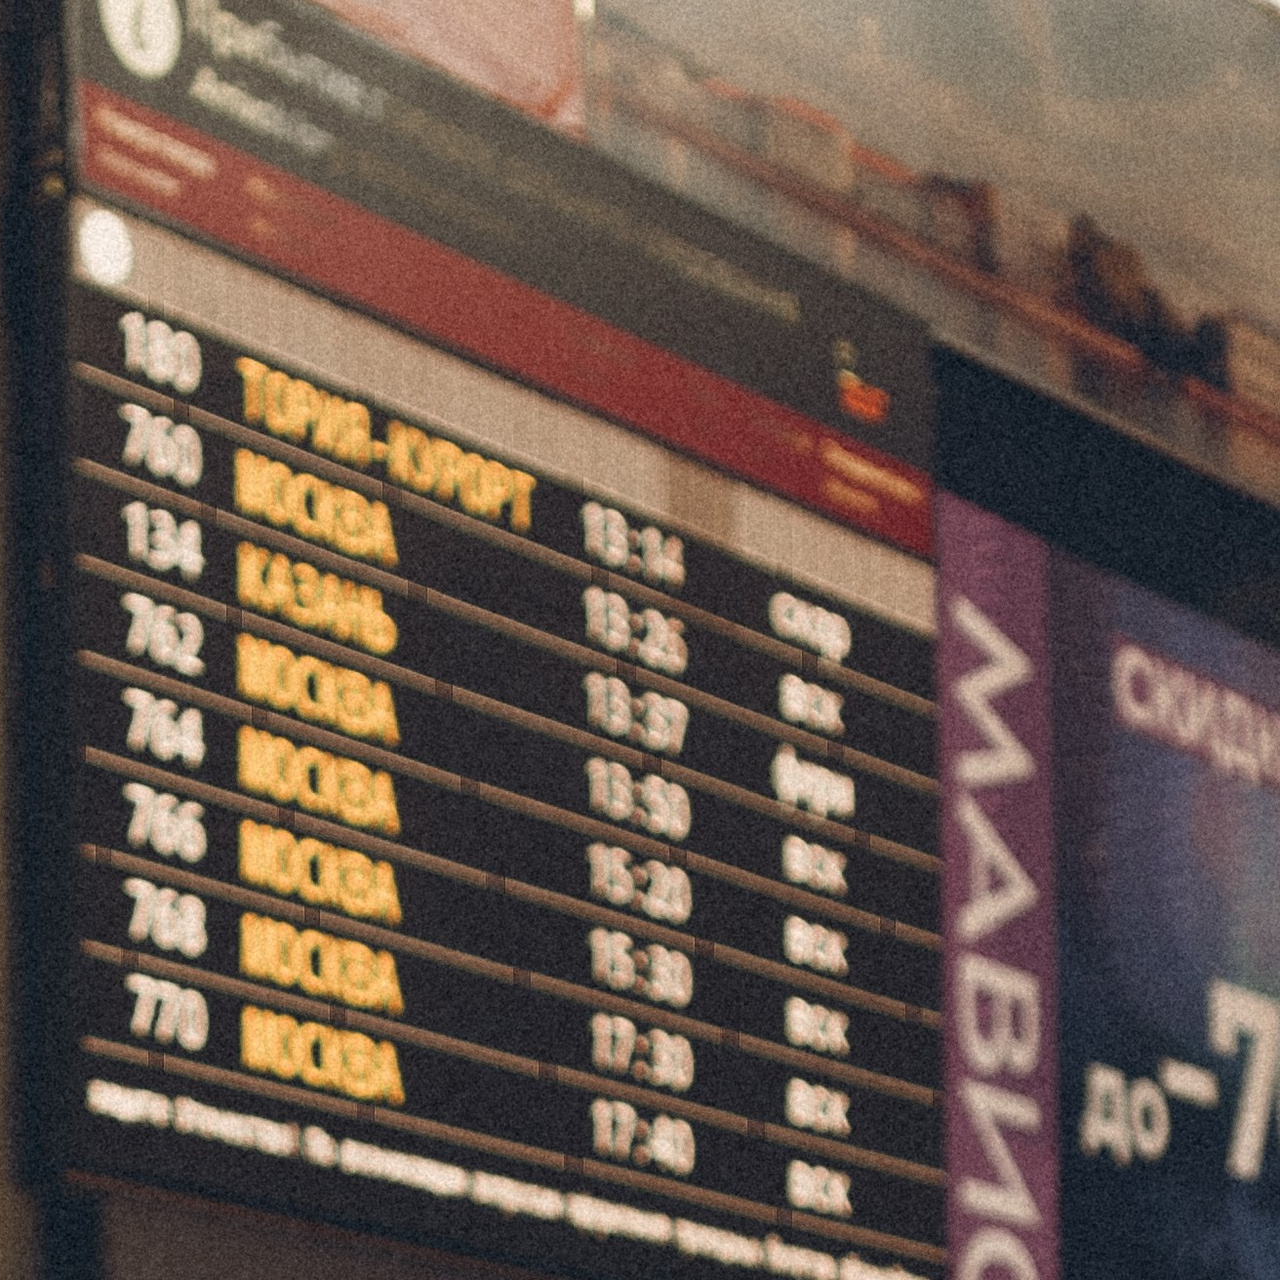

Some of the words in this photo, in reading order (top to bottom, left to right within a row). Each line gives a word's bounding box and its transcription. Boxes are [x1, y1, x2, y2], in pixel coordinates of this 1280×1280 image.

[118, 404, 203, 486] 760
[234, 448, 399, 565] МОСКВА
[121, 500, 205, 579] 134
[236, 542, 398, 654] КАЗАНЬ
[122, 593, 205, 676] 762
[237, 633, 400, 743] МОСКВА
[122, 687, 206, 767] 764
[237, 725, 401, 836] МОСКВА
[123, 782, 207, 862] 766
[239, 819, 402, 924] МОСКВА
[240, 912, 403, 1012] МОСКВА
[125, 972, 209, 1051] 770
[241, 1005, 405, 1105] МОСКВА
